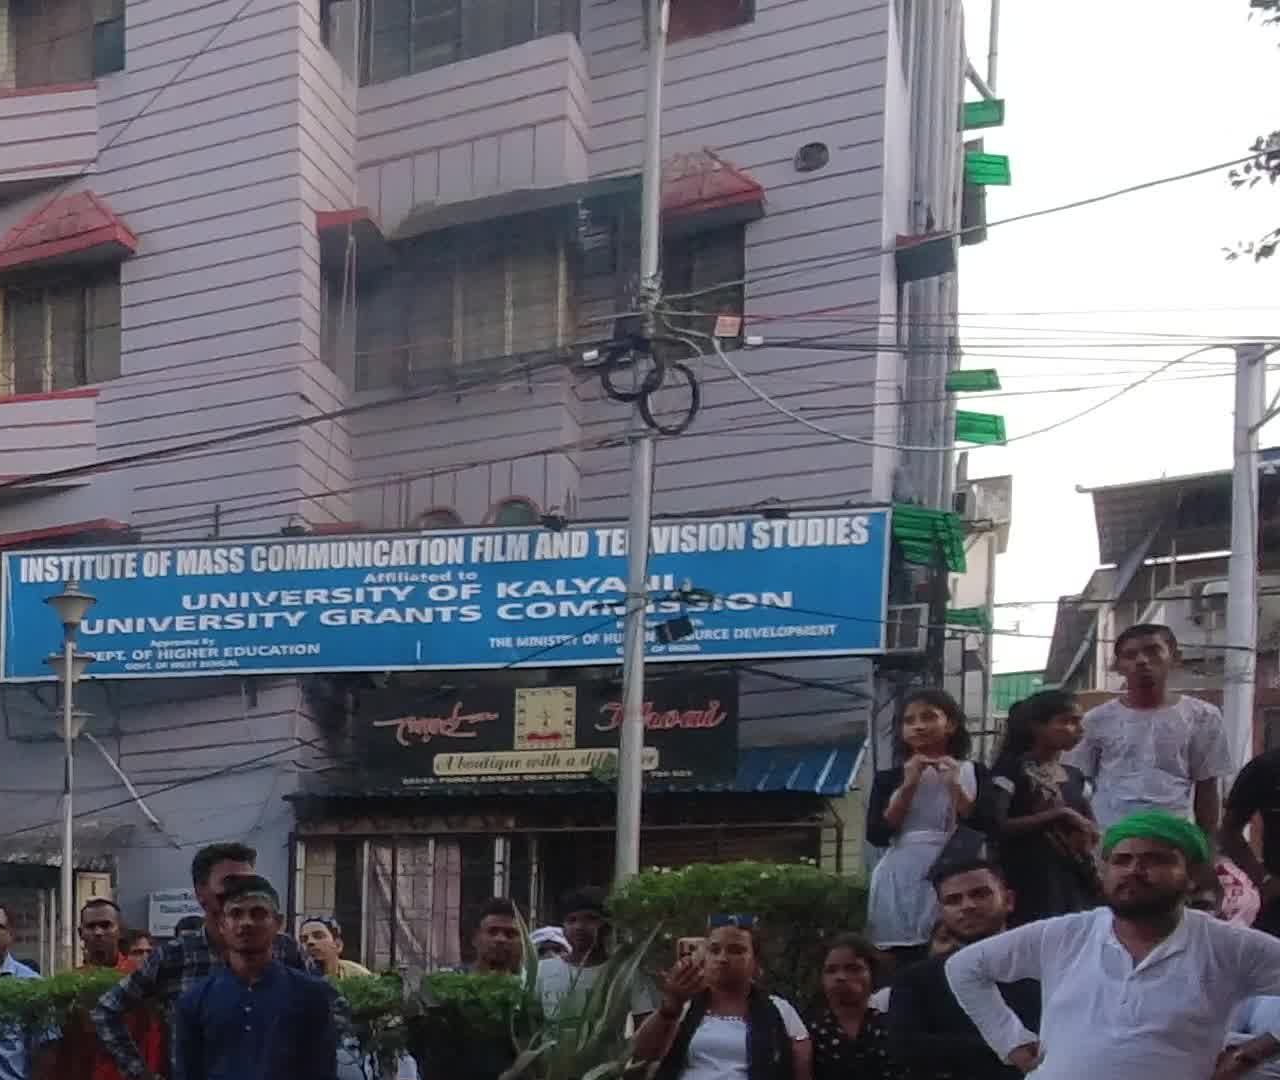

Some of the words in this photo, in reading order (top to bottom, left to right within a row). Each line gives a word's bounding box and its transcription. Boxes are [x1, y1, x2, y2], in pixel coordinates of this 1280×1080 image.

[20, 552, 137, 583] INSTITUTE
[143, 551, 172, 578] OF
[177, 547, 245, 576] MASS
[251, 537, 465, 573] COMMUNICATION
[471, 533, 529, 564] FILM
[534, 529, 590, 560] AND
[595, 521, 746, 557] TEVISION
[752, 515, 870, 550] STUDIES
[364, 571, 452, 585] Affiliated
[458, 571, 479, 582] to
[181, 585, 416, 611] UNIVERSITY
[428, 583, 482, 602] OF
[80, 610, 306, 635] UNIVERSITY
[319, 605, 483, 627] GRANTS
[582, 633, 600, 645] OF
[733, 624, 837, 640] DEVELOPMENT
[132, 650, 153, 661] OF
[157, 648, 219, 660] HIGHER
[223, 643, 321, 657] EDUCATION
[525, 751, 561, 767] with
[565, 756, 576, 767] a
